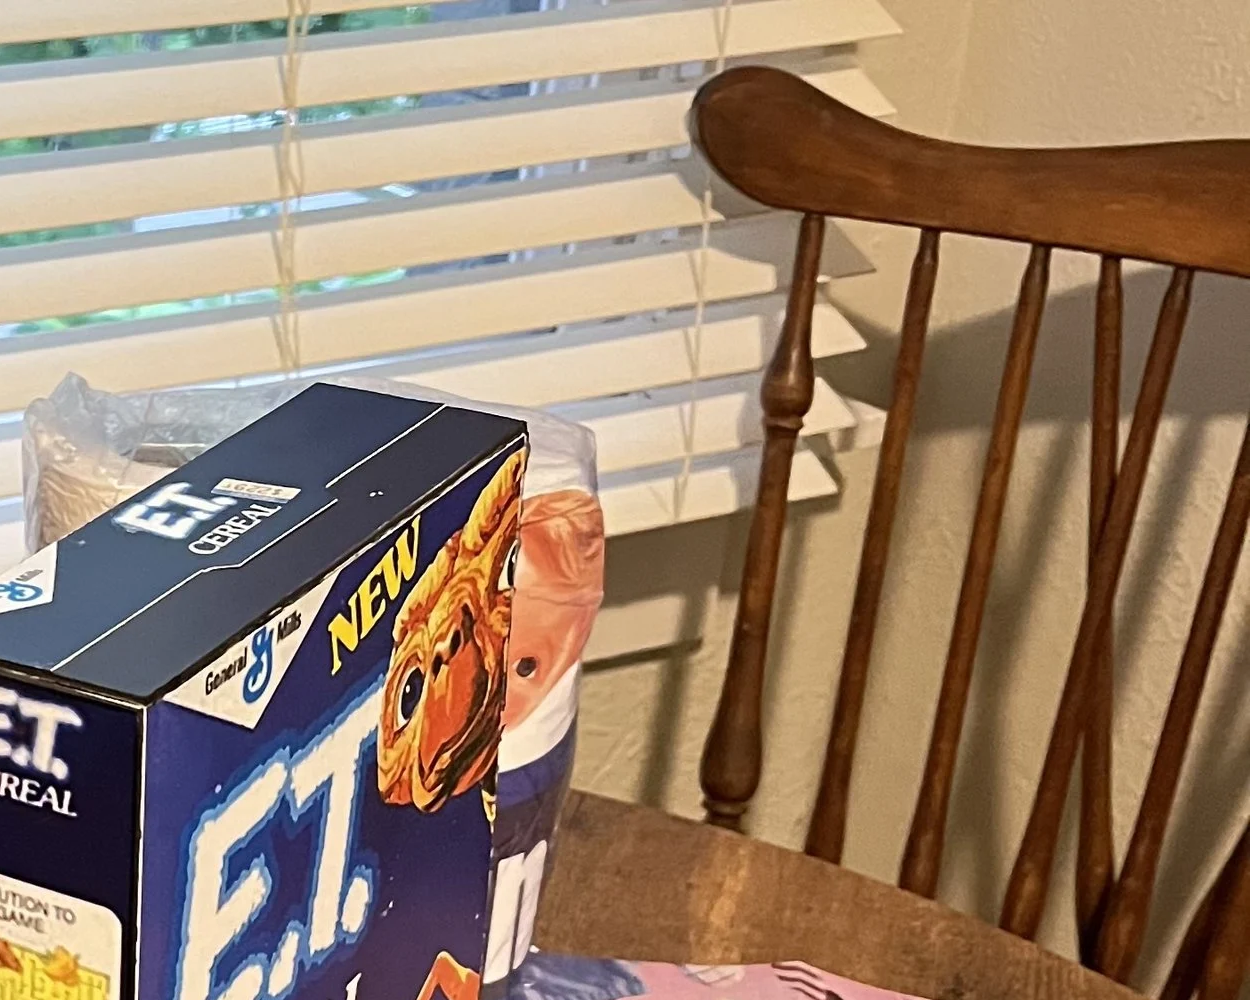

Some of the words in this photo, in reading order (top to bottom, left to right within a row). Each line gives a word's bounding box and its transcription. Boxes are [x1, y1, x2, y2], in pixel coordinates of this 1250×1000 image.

[112, 482, 238, 540] E.T.
[188, 503, 283, 555] CEREAL
[328, 515, 421, 676] NEW
[205, 647, 248, 696] General
[277, 610, 302, 645] Mills
[51, 903, 76, 925] TO
